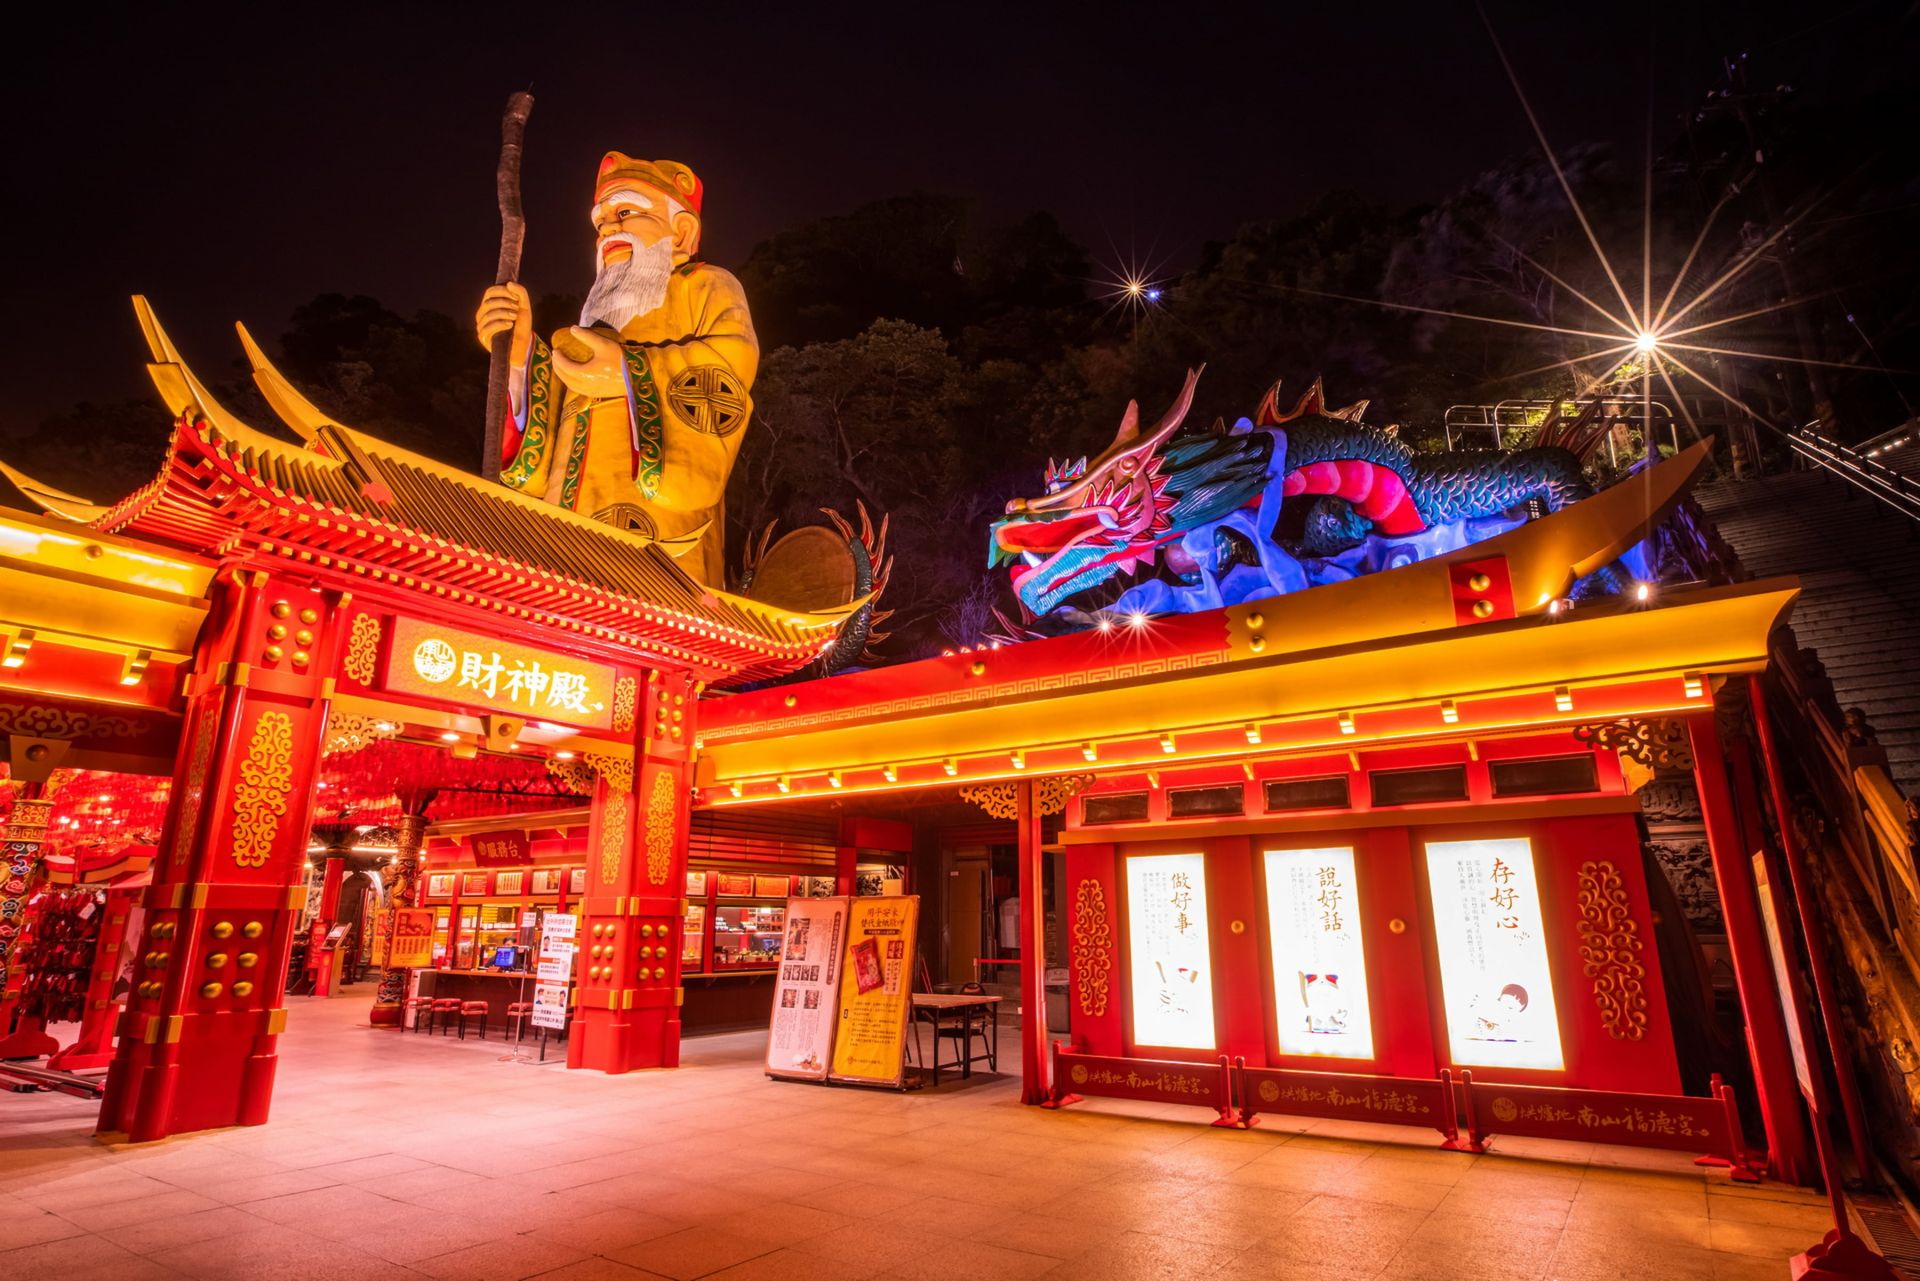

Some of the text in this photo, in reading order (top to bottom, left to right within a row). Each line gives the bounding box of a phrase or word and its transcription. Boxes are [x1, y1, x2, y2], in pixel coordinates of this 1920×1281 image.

[457, 651, 591, 713] 財神殿
[1170, 872, 1193, 935] 做好事
[1315, 866, 1344, 931] 說好話
[1489, 857, 1520, 929] 存好心
